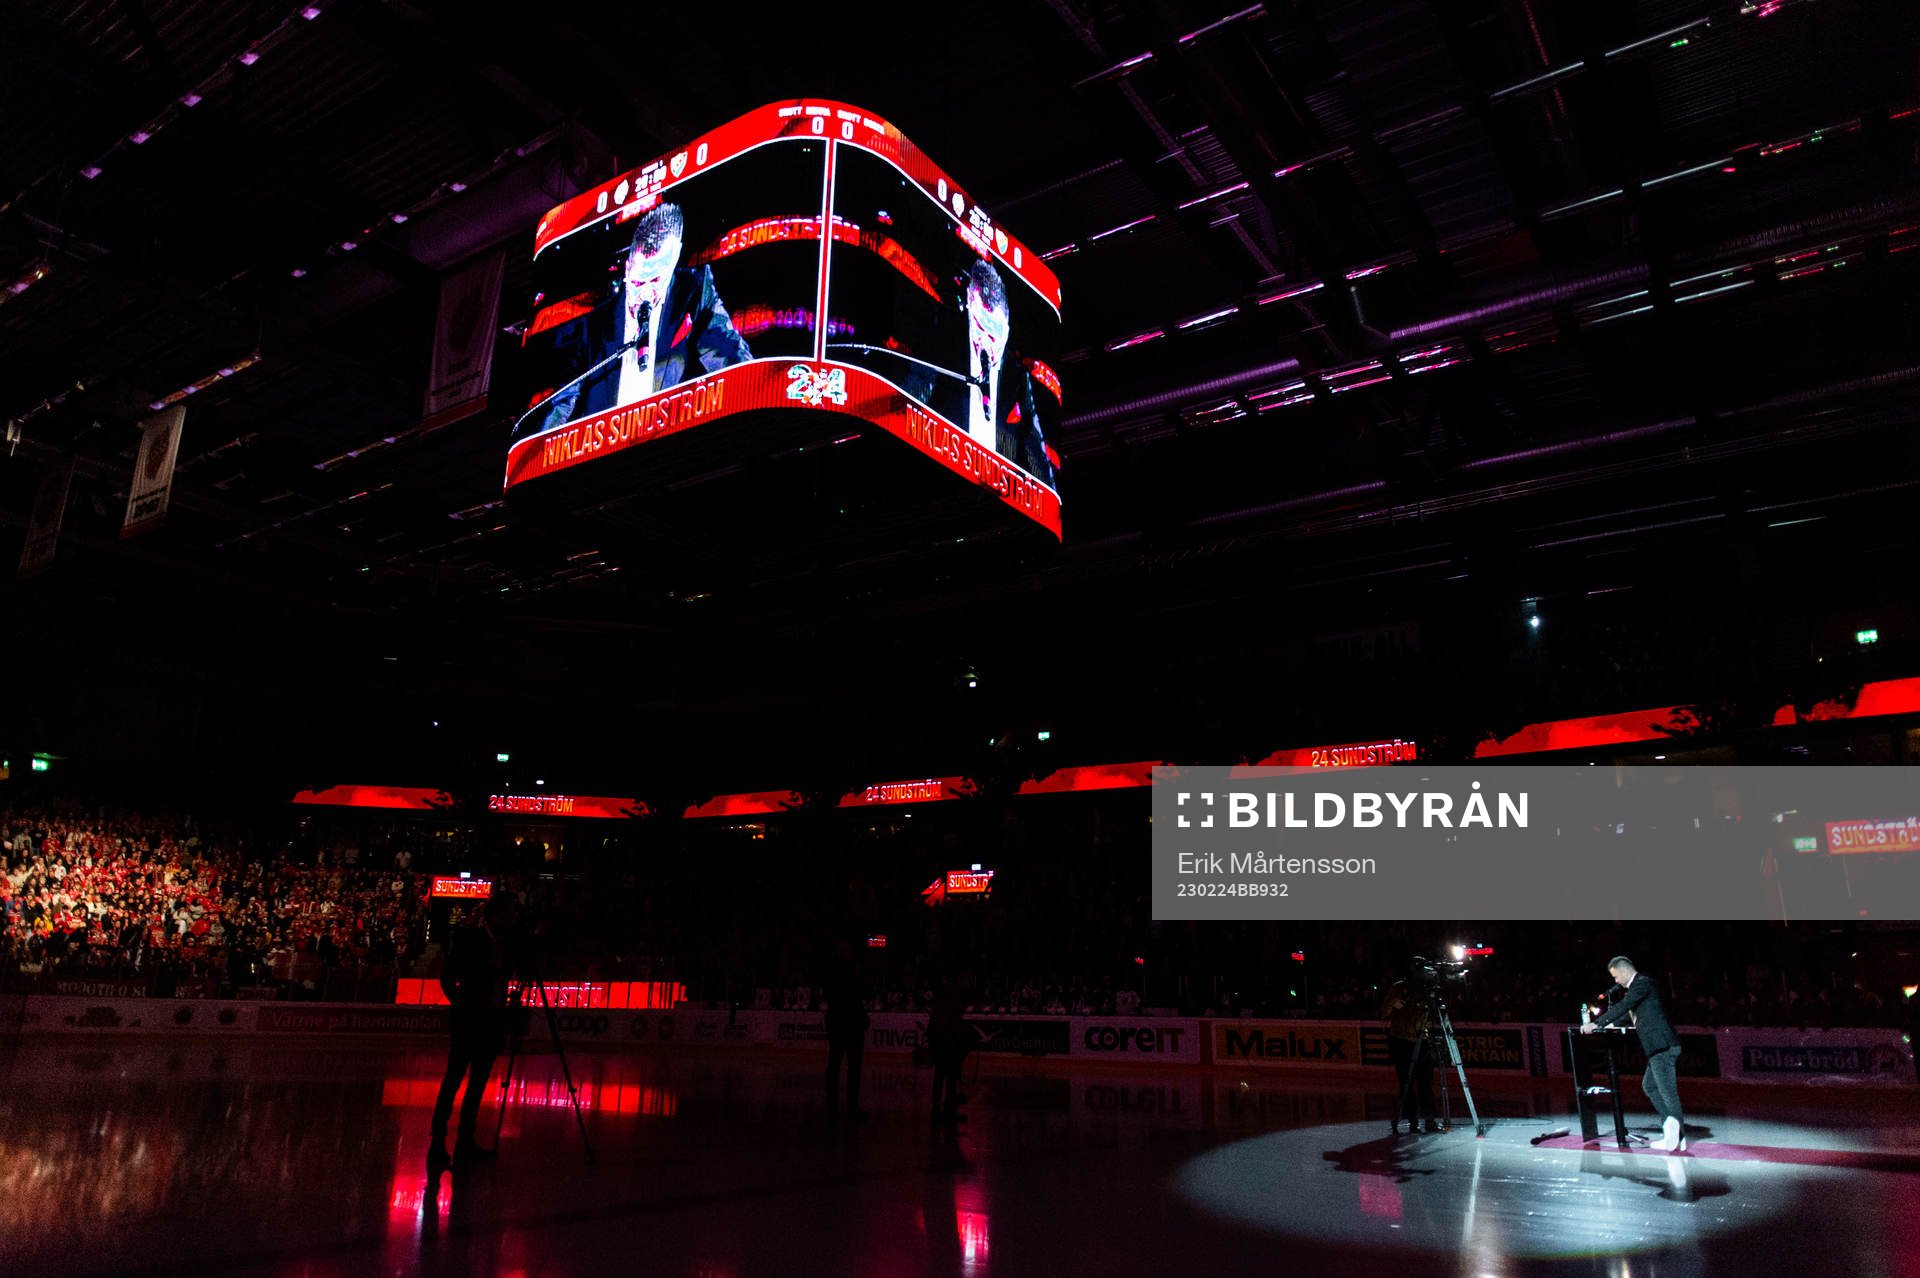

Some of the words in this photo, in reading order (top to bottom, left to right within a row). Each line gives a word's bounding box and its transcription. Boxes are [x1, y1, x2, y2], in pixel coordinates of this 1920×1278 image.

[812, 116, 824, 134] 0
[842, 121, 854, 140] 0
[696, 143, 708, 166] 0
[938, 178, 947, 202] 0
[597, 191, 608, 213] 0
[1014, 247, 1022, 269] 0
[543, 420, 605, 468] NIKLAS
[608, 378, 725, 446] SUNDSTRÖM
[906, 403, 960, 463] NIKLAS
[963, 441, 1044, 517] SUNDSTRÖM
[1312, 750, 1328, 768] 24
[1331, 739, 1417, 767] SUNDSTRÖM
[866, 786, 879, 801] 24
[881, 779, 941, 800] SUNDSTRÖM
[488, 794, 504, 810] 24
[506, 795, 574, 813] SUNDSTRÖM
[1832, 816, 1920, 847] SUNDSTRÖ
[557, 1014, 608, 1037] coop
[1226, 1029, 1347, 1059] Malux
